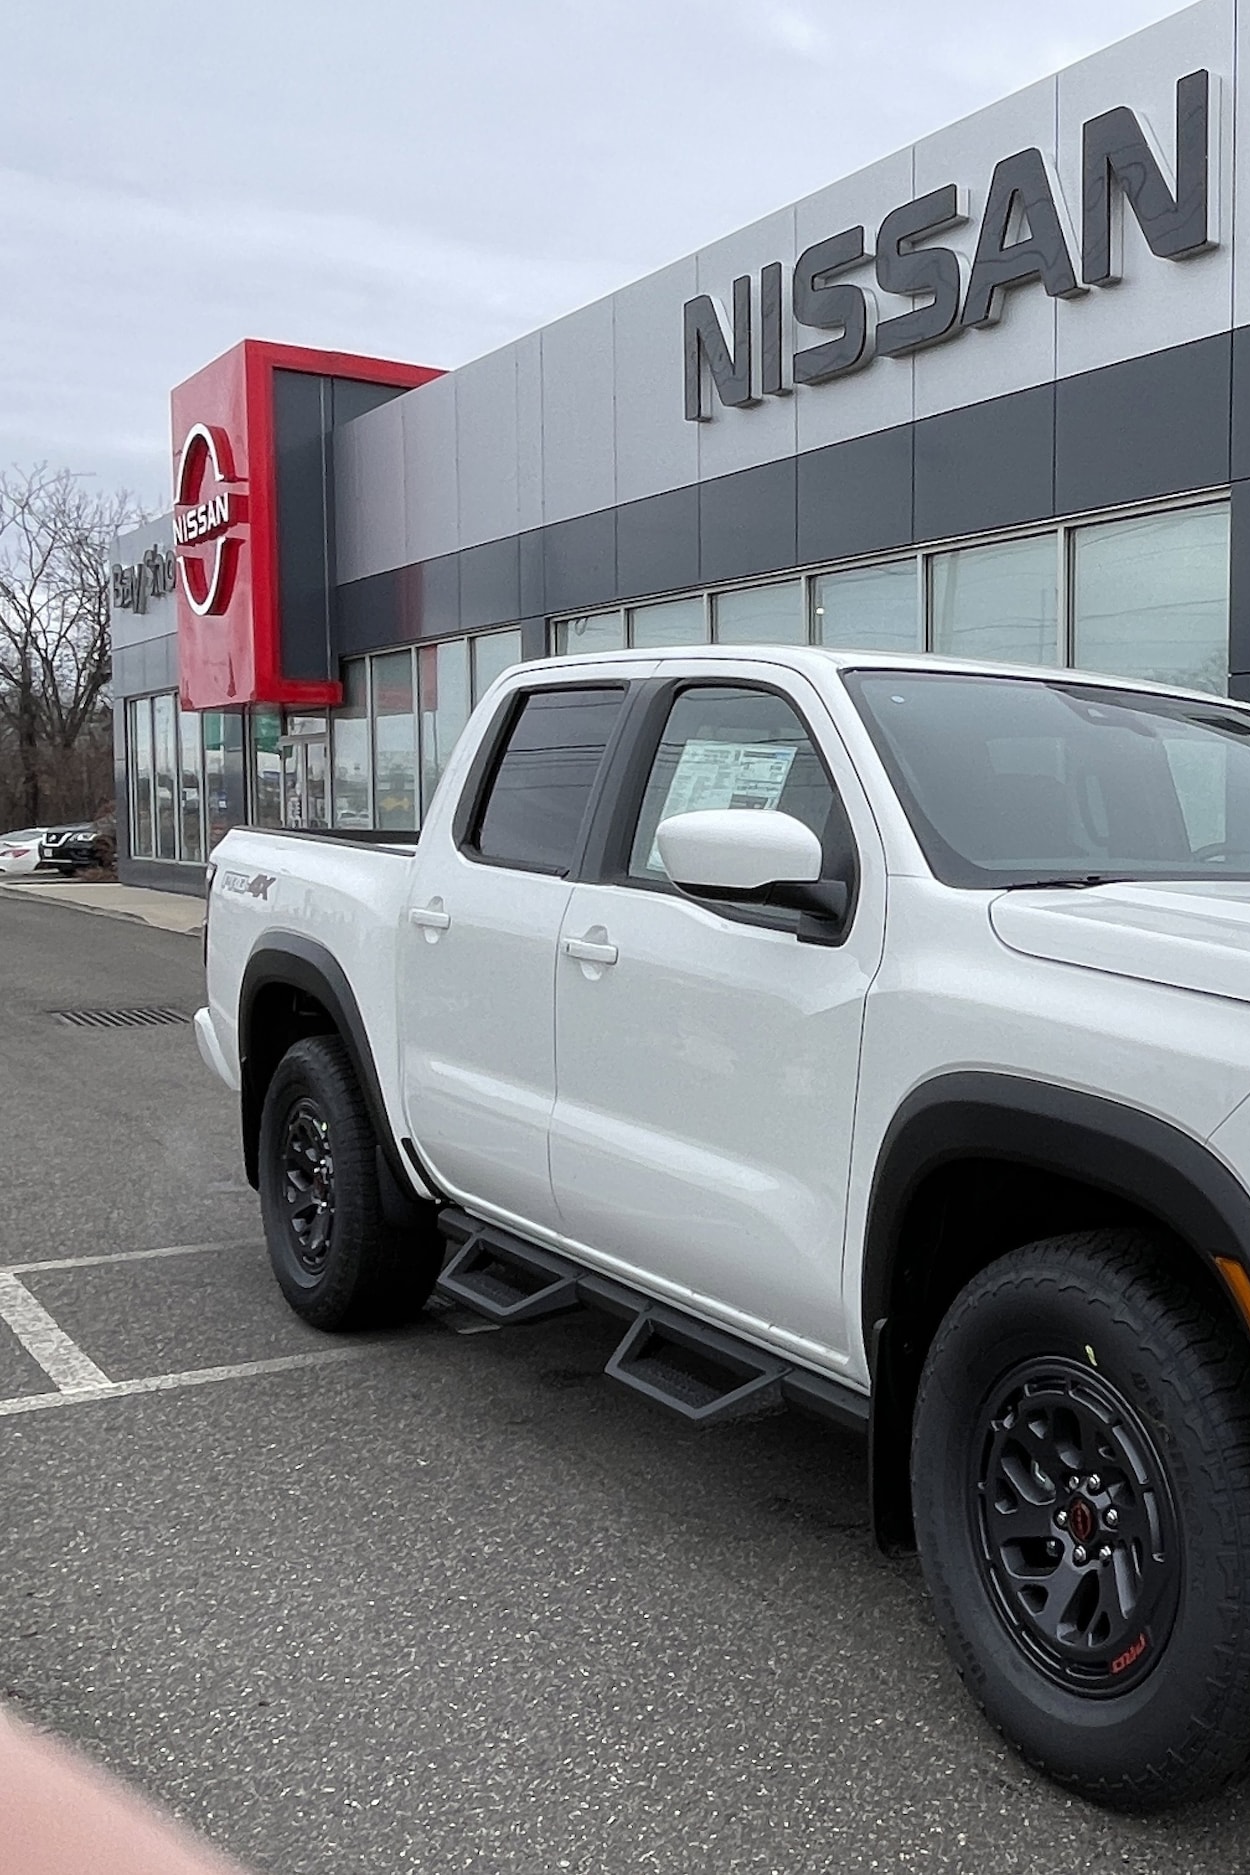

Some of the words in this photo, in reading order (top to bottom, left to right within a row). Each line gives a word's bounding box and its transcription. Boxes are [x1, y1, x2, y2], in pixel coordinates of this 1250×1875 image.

[683, 68, 1222, 423] NISSAN
[173, 492, 230, 546] NISSAN
[144, 543, 177, 598] Sho
